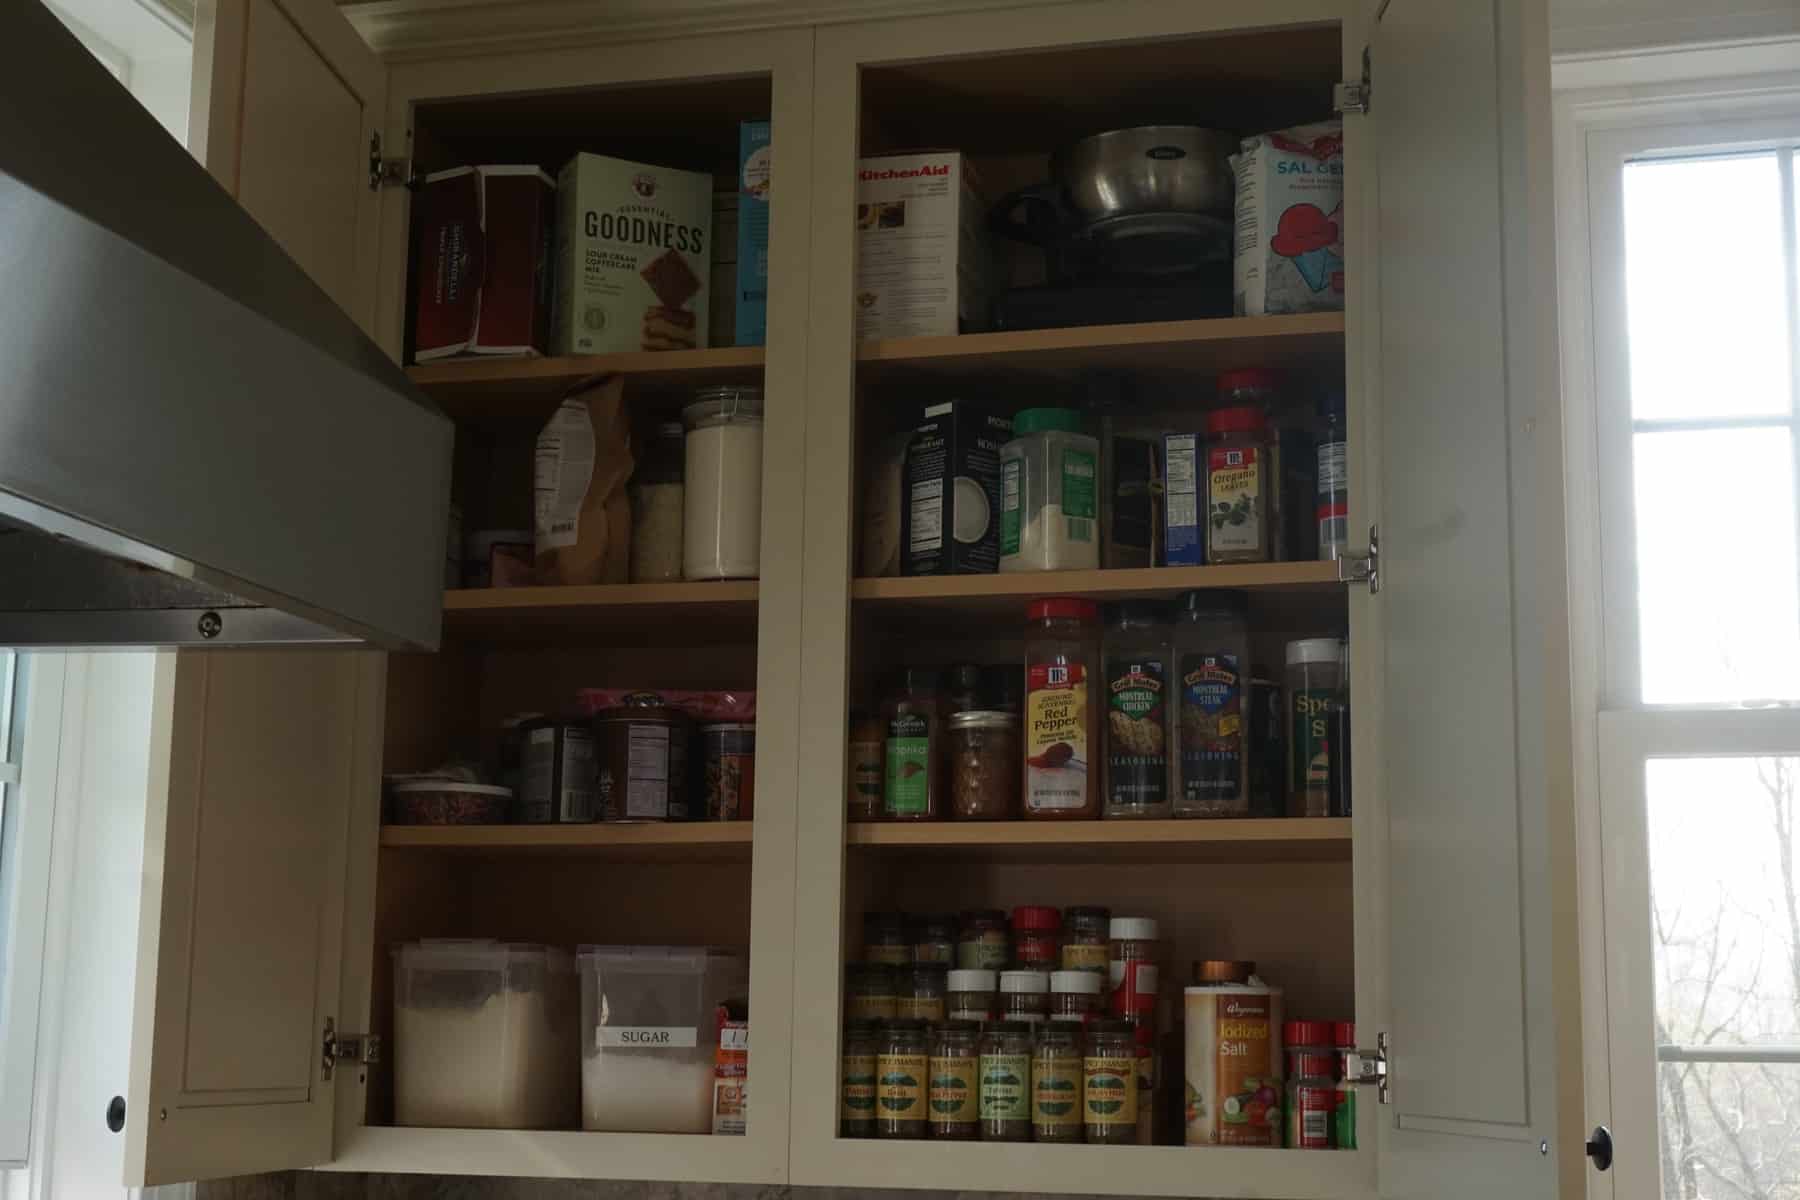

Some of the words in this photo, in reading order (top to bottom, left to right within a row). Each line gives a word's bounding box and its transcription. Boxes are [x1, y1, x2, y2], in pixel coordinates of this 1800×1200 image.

[1278, 161, 1312, 174] SAL
[585, 211, 704, 255] GOODNESS
[586, 249, 608, 259] SOUR
[610, 252, 638, 263] CREAM
[1213, 469, 1256, 484] Oregano
[1199, 695, 1222, 705] STEAK
[1044, 707, 1069, 721] Red
[1034, 716, 1078, 732] Pepper
[621, 1031, 670, 1042] SUGAR
[1219, 1023, 1267, 1039] Iodized
[1218, 1041, 1249, 1056] Salt
